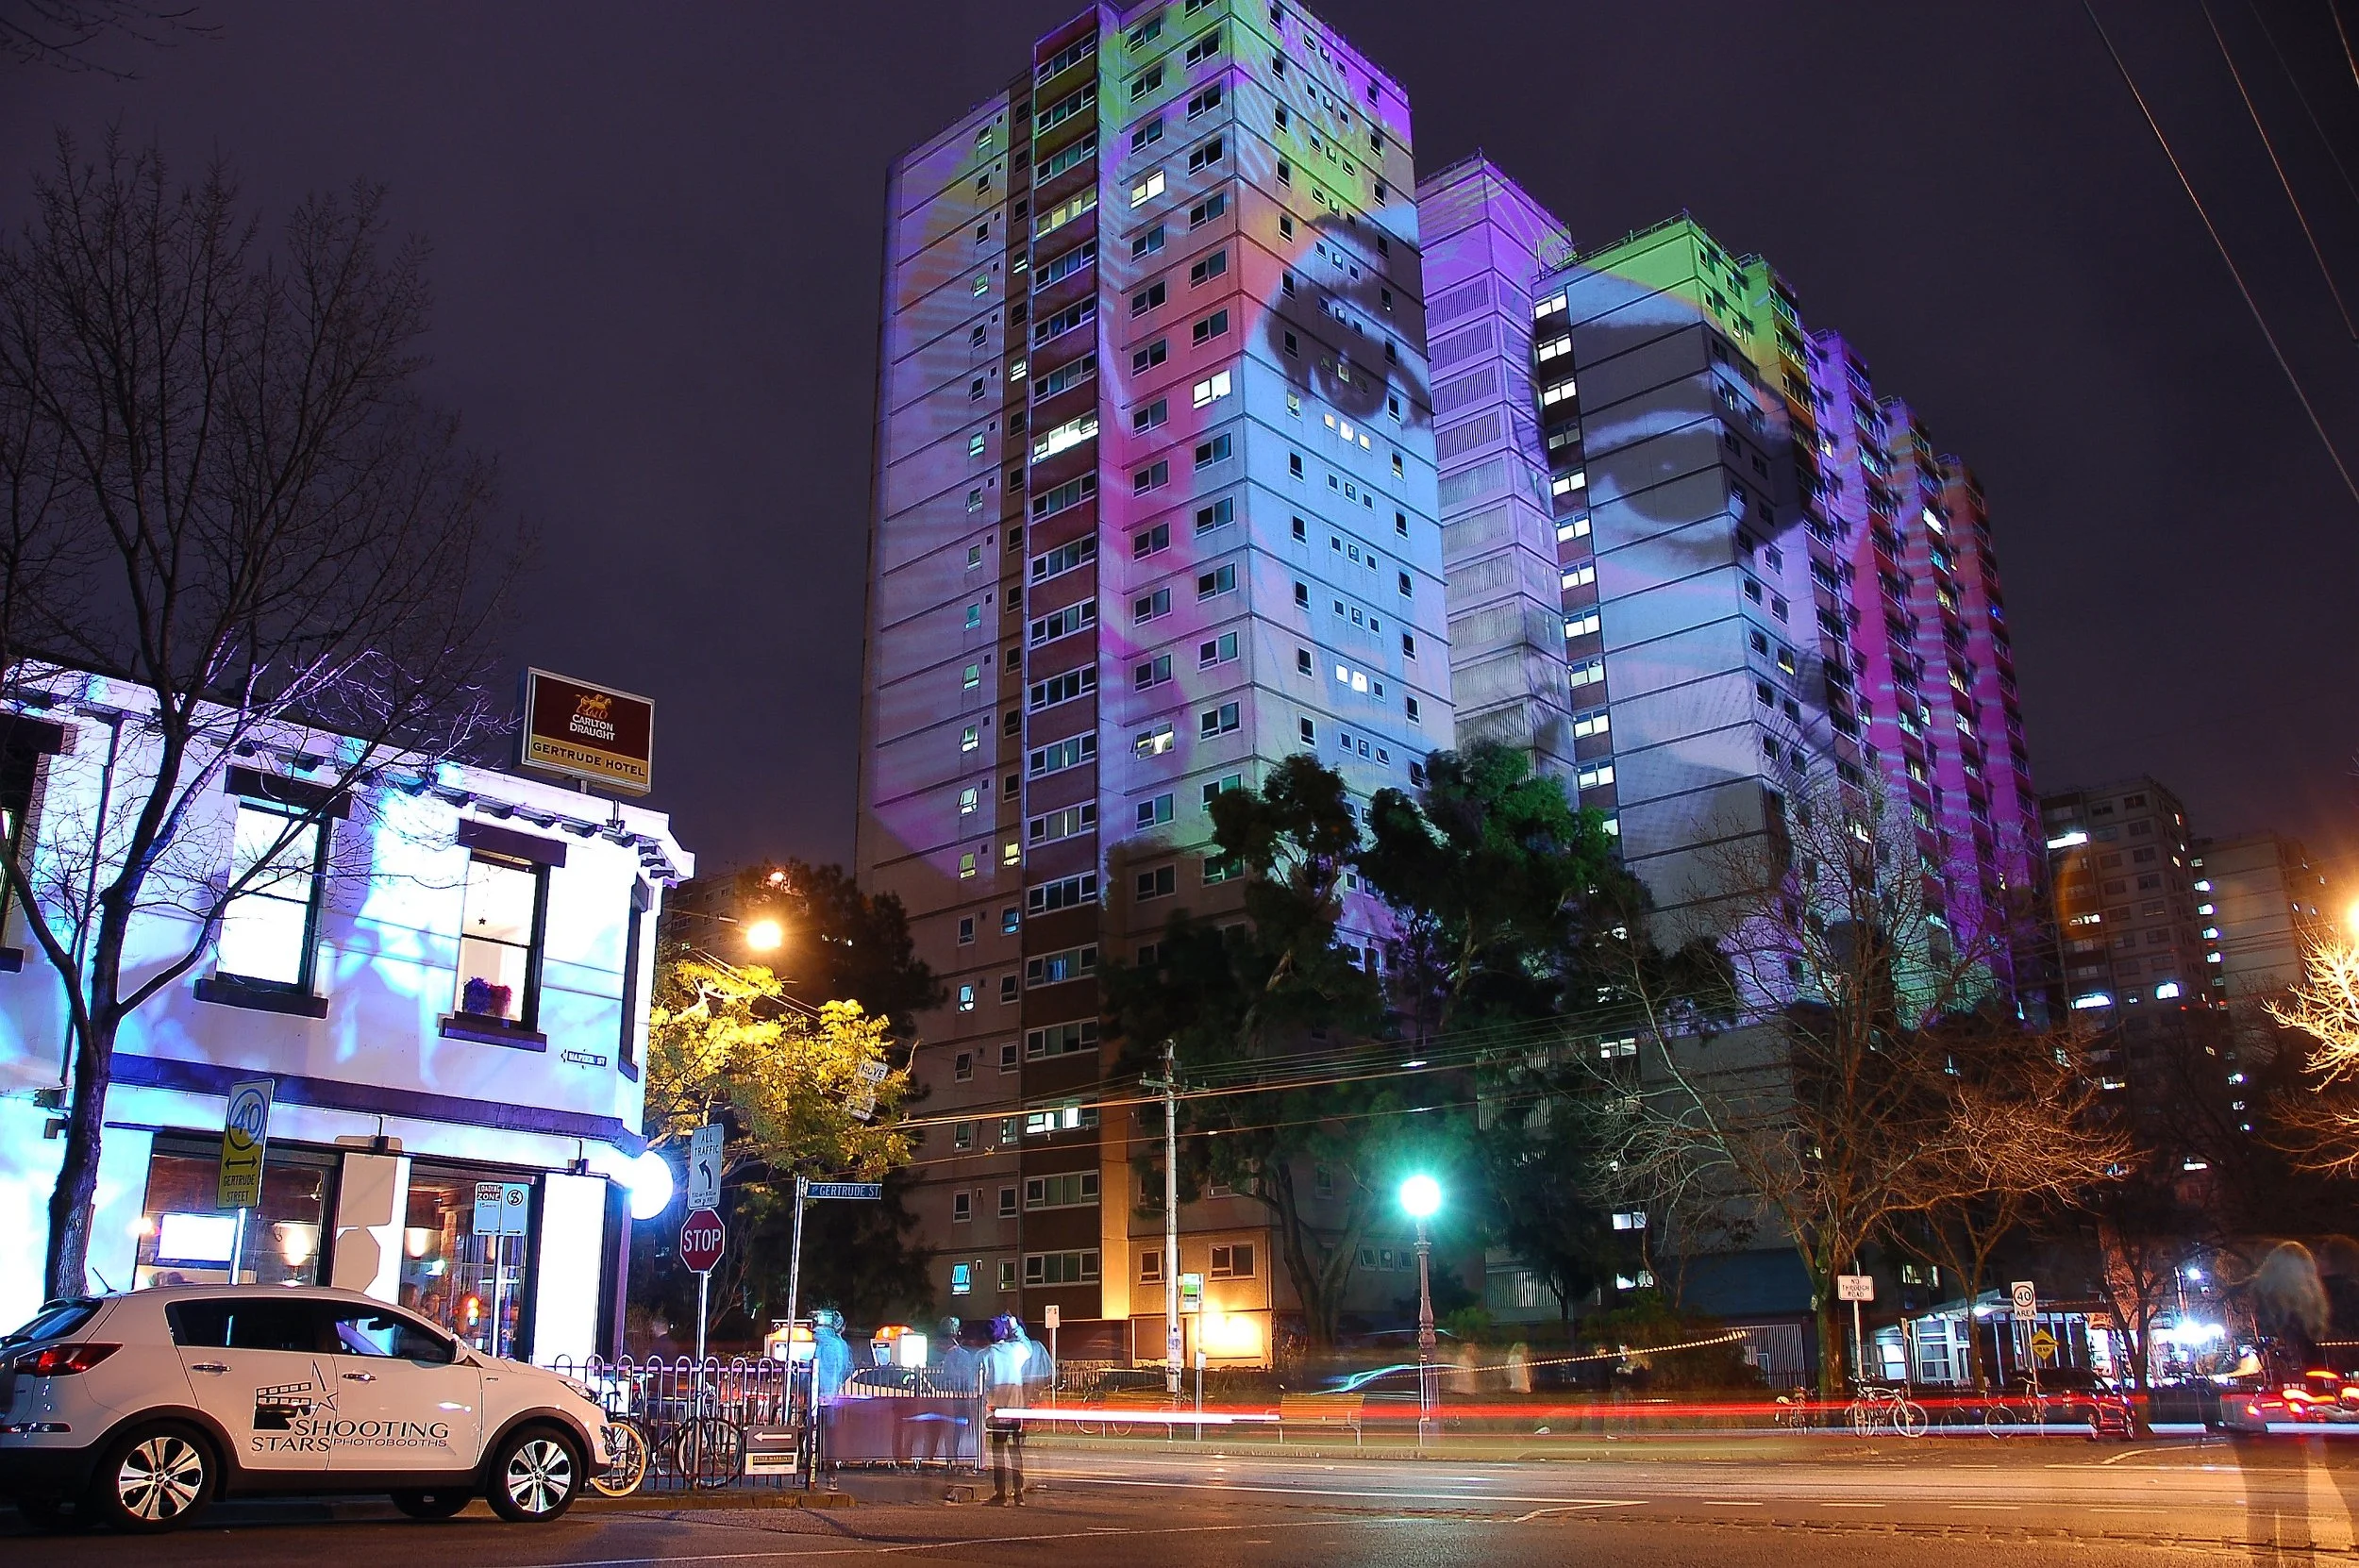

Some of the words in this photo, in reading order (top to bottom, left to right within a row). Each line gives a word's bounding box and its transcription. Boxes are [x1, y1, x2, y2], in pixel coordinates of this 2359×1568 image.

[572, 714, 613, 732] CARLTON
[569, 722, 615, 741] DRAUGHT
[532, 742, 602, 767] GERTRUDE
[605, 759, 645, 777] HOTEL
[231, 1103, 262, 1136] 40
[700, 1133, 713, 1143] ALL
[694, 1144, 719, 1158] TRAFFIC
[223, 1174, 256, 1187] GERTRUDE
[226, 1190, 249, 1203] STREET
[477, 1193, 500, 1201] ZONE
[819, 1185, 866, 1197] GERTRUDE
[868, 1186, 879, 1197] ST
[683, 1228, 722, 1253] STOP
[2016, 1291, 2032, 1302] 40
[2016, 1309, 2036, 1318] AREA
[293, 1419, 449, 1439] SHOOTING
[251, 1436, 330, 1452] STARS
[333, 1438, 447, 1447] PHOTOBOOTHS
